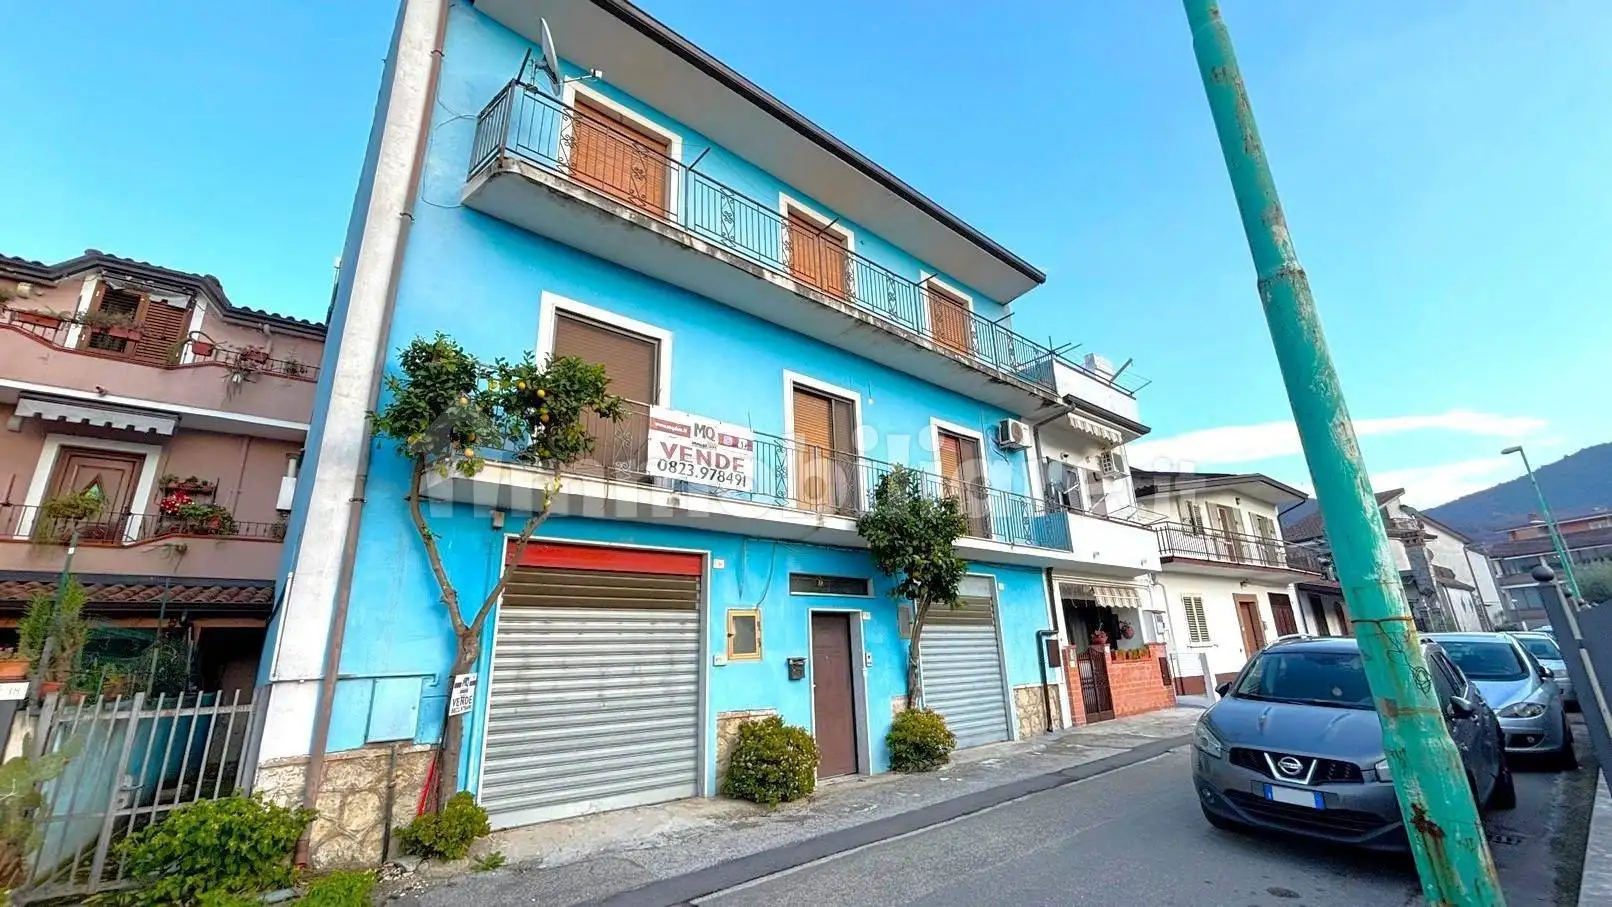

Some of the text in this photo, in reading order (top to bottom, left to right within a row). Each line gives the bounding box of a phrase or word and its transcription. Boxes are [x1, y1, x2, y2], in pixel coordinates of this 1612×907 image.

[694, 423, 715, 441] MQ
[660, 441, 744, 474] VENDE
[657, 459, 746, 487] 0823.978491
[452, 695, 472, 706] VENDE
